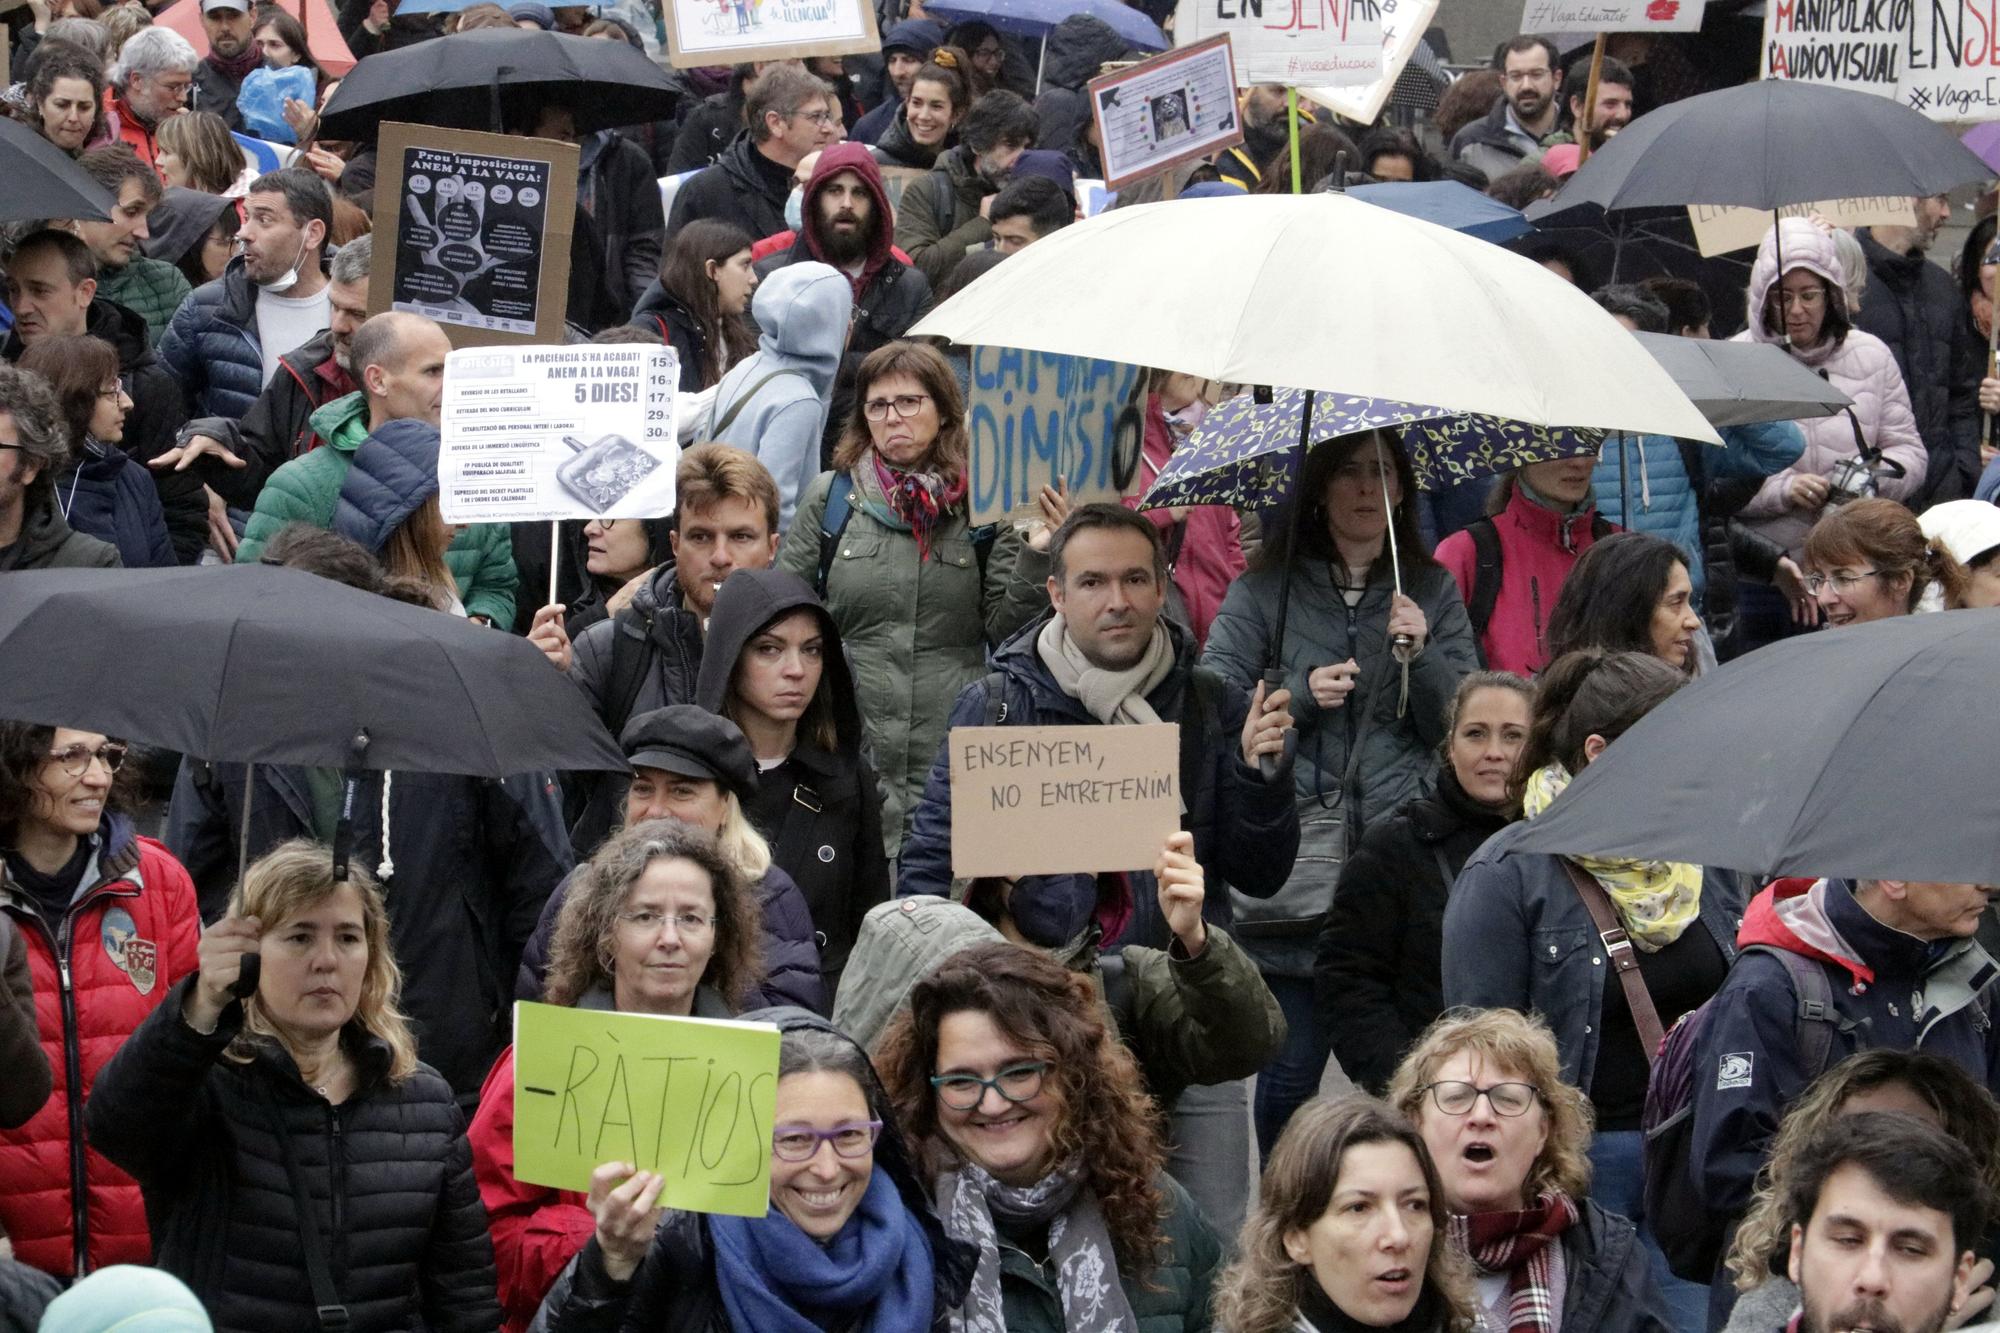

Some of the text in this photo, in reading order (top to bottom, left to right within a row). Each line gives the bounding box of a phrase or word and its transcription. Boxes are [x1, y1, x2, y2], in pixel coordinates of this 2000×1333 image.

[411, 160, 541, 182] ANEM A LA VAGA!
[418, 151, 536, 172] Prou imposicions
[522, 355, 532, 364] LA
[582, 353, 601, 362] S'HA
[548, 366, 640, 378] ANEM A LA VAGA!
[575, 382, 638, 404] 5 DIES!
[964, 740, 1104, 771] ENSENYEM,
[991, 784, 1020, 810] NO
